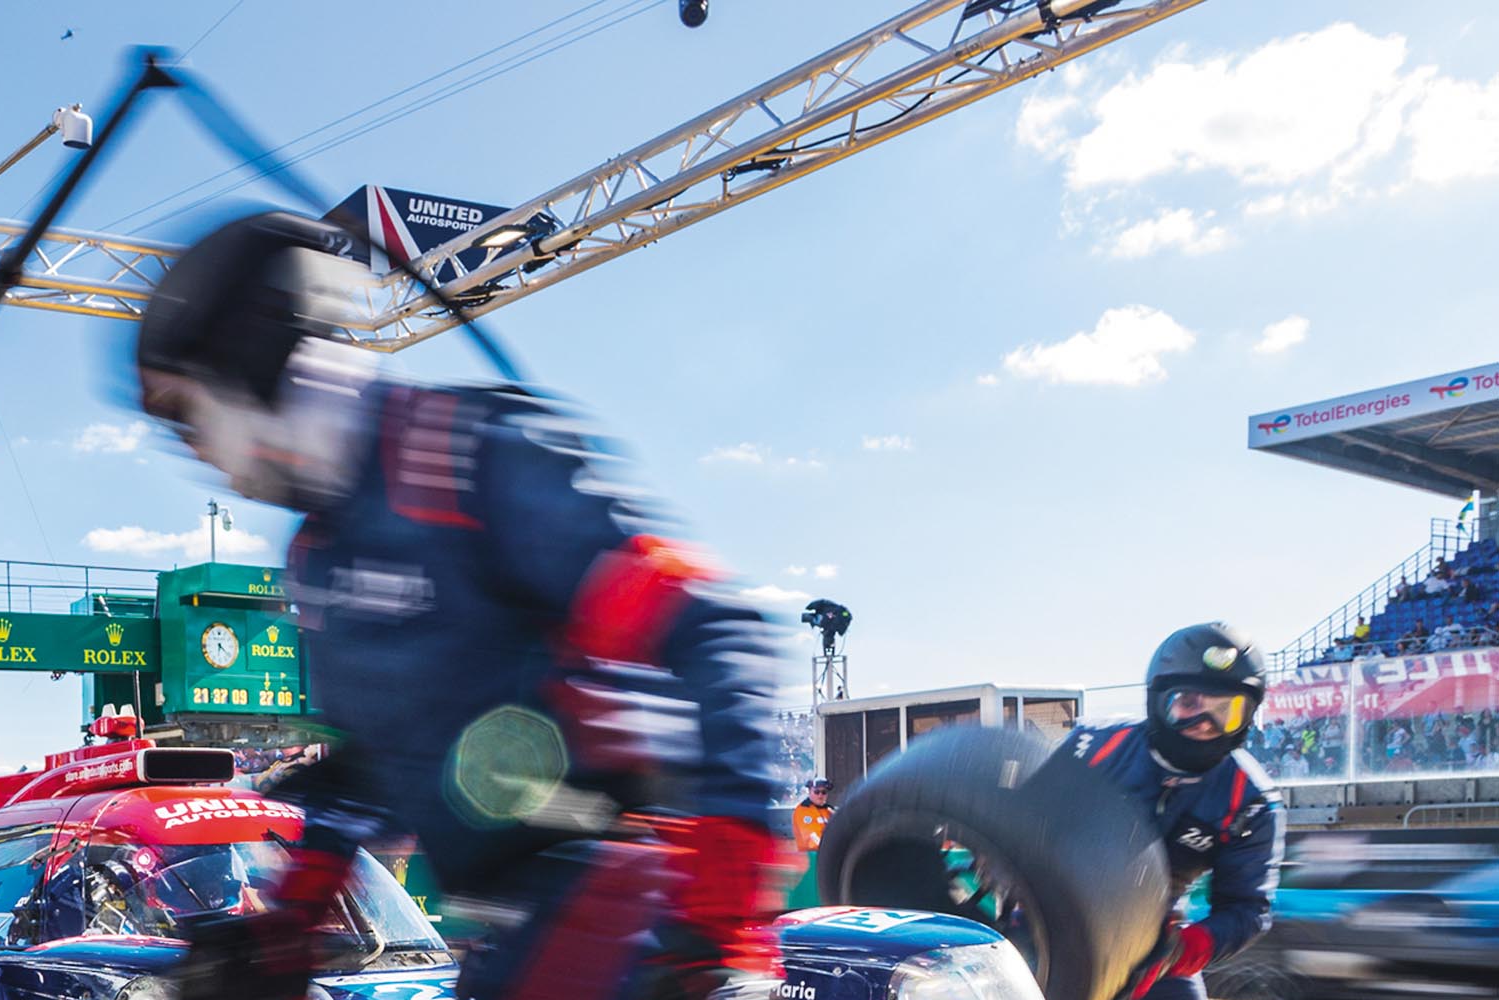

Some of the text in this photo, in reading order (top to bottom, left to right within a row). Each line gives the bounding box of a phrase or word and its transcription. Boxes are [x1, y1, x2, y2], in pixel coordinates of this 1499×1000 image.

[408, 198, 483, 223] UNITED
[1293, 394, 1411, 428] TotalEnergies
[83, 649, 147, 666] ROLEX
[251, 645, 295, 658] ROLEX
